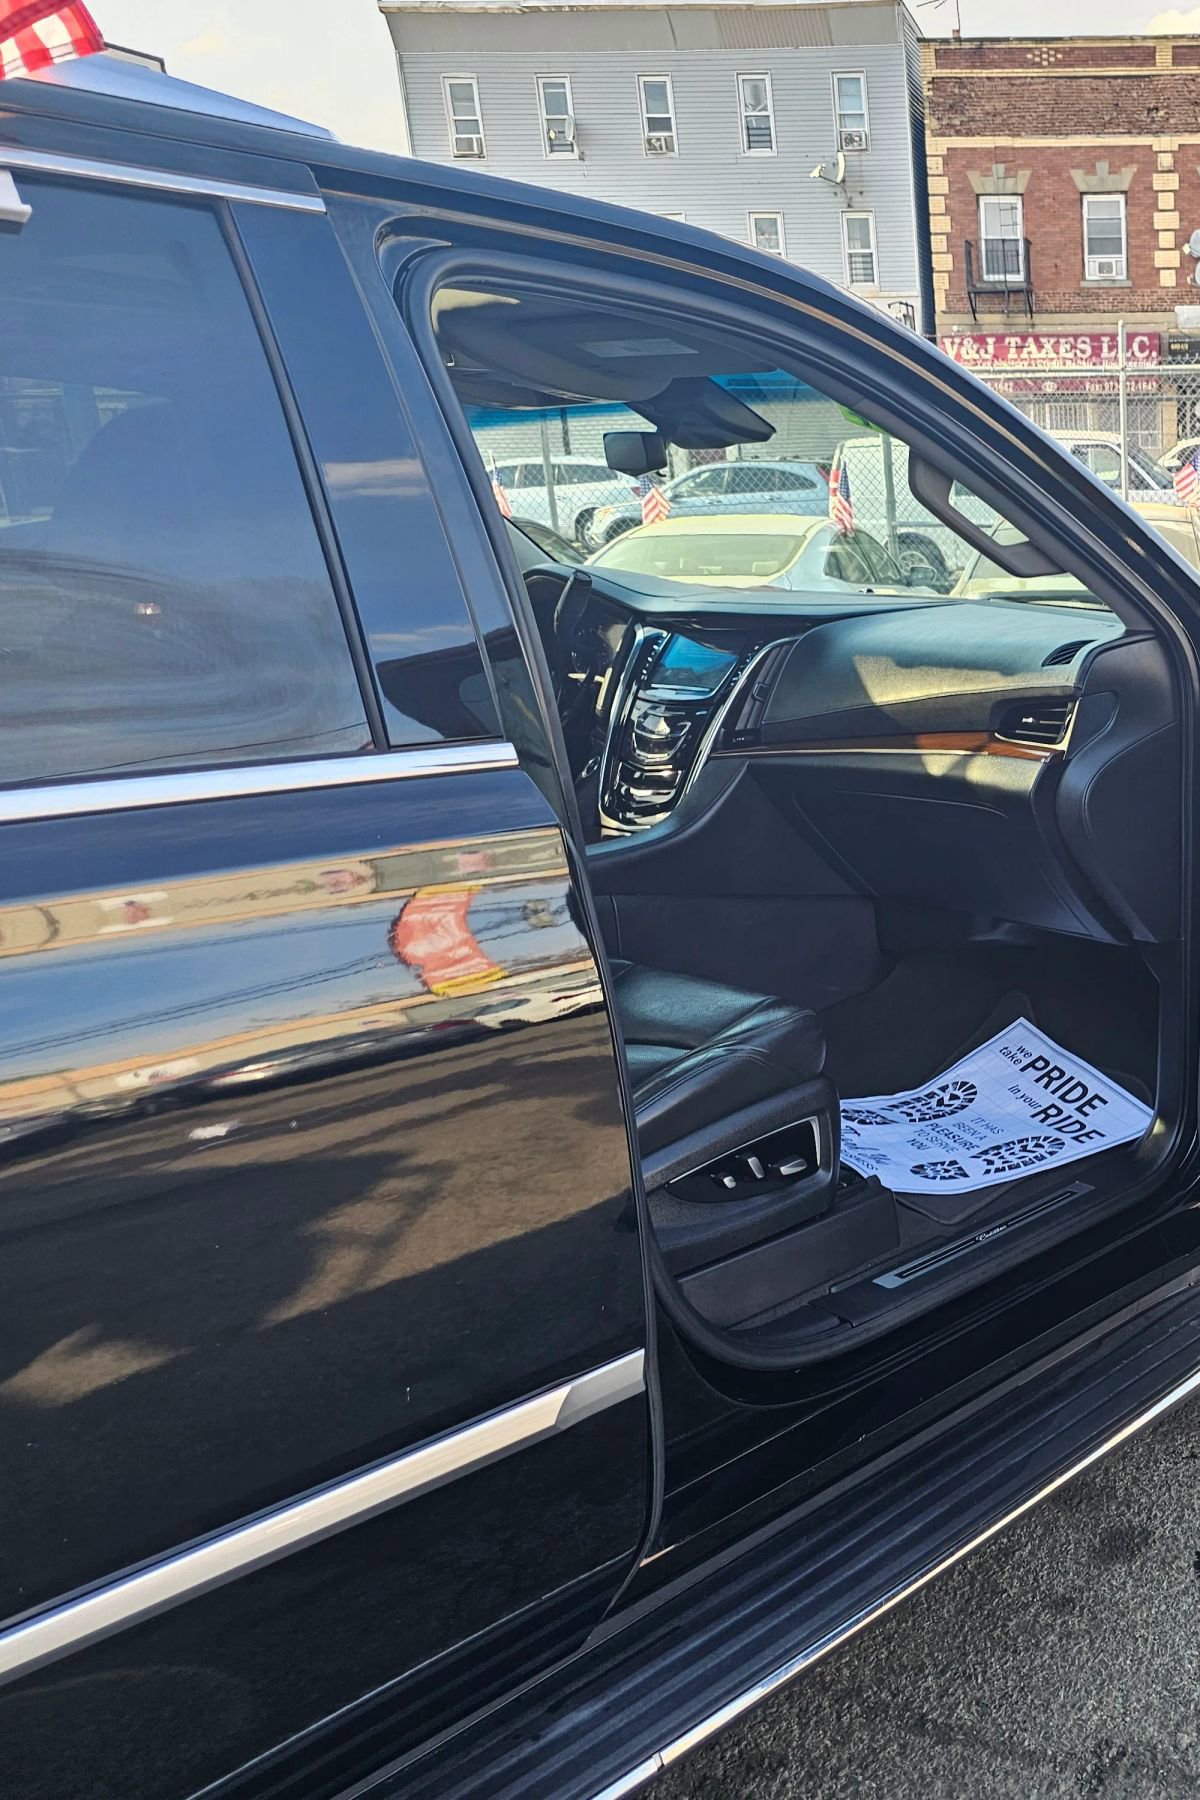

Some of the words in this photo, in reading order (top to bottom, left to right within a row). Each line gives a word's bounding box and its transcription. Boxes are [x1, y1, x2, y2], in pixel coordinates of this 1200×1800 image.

[943, 337, 996, 360] V&J
[1005, 335, 1092, 359] TAXES
[1017, 1045, 1033, 1059] we
[999, 1046, 1022, 1065] take
[1019, 1055, 1109, 1117] PRIDE
[1008, 1084, 1021, 1095] in
[1016, 1093, 1042, 1110] your
[1030, 1103, 1106, 1144] RIDE
[925, 1122, 980, 1151] PLEASURE
